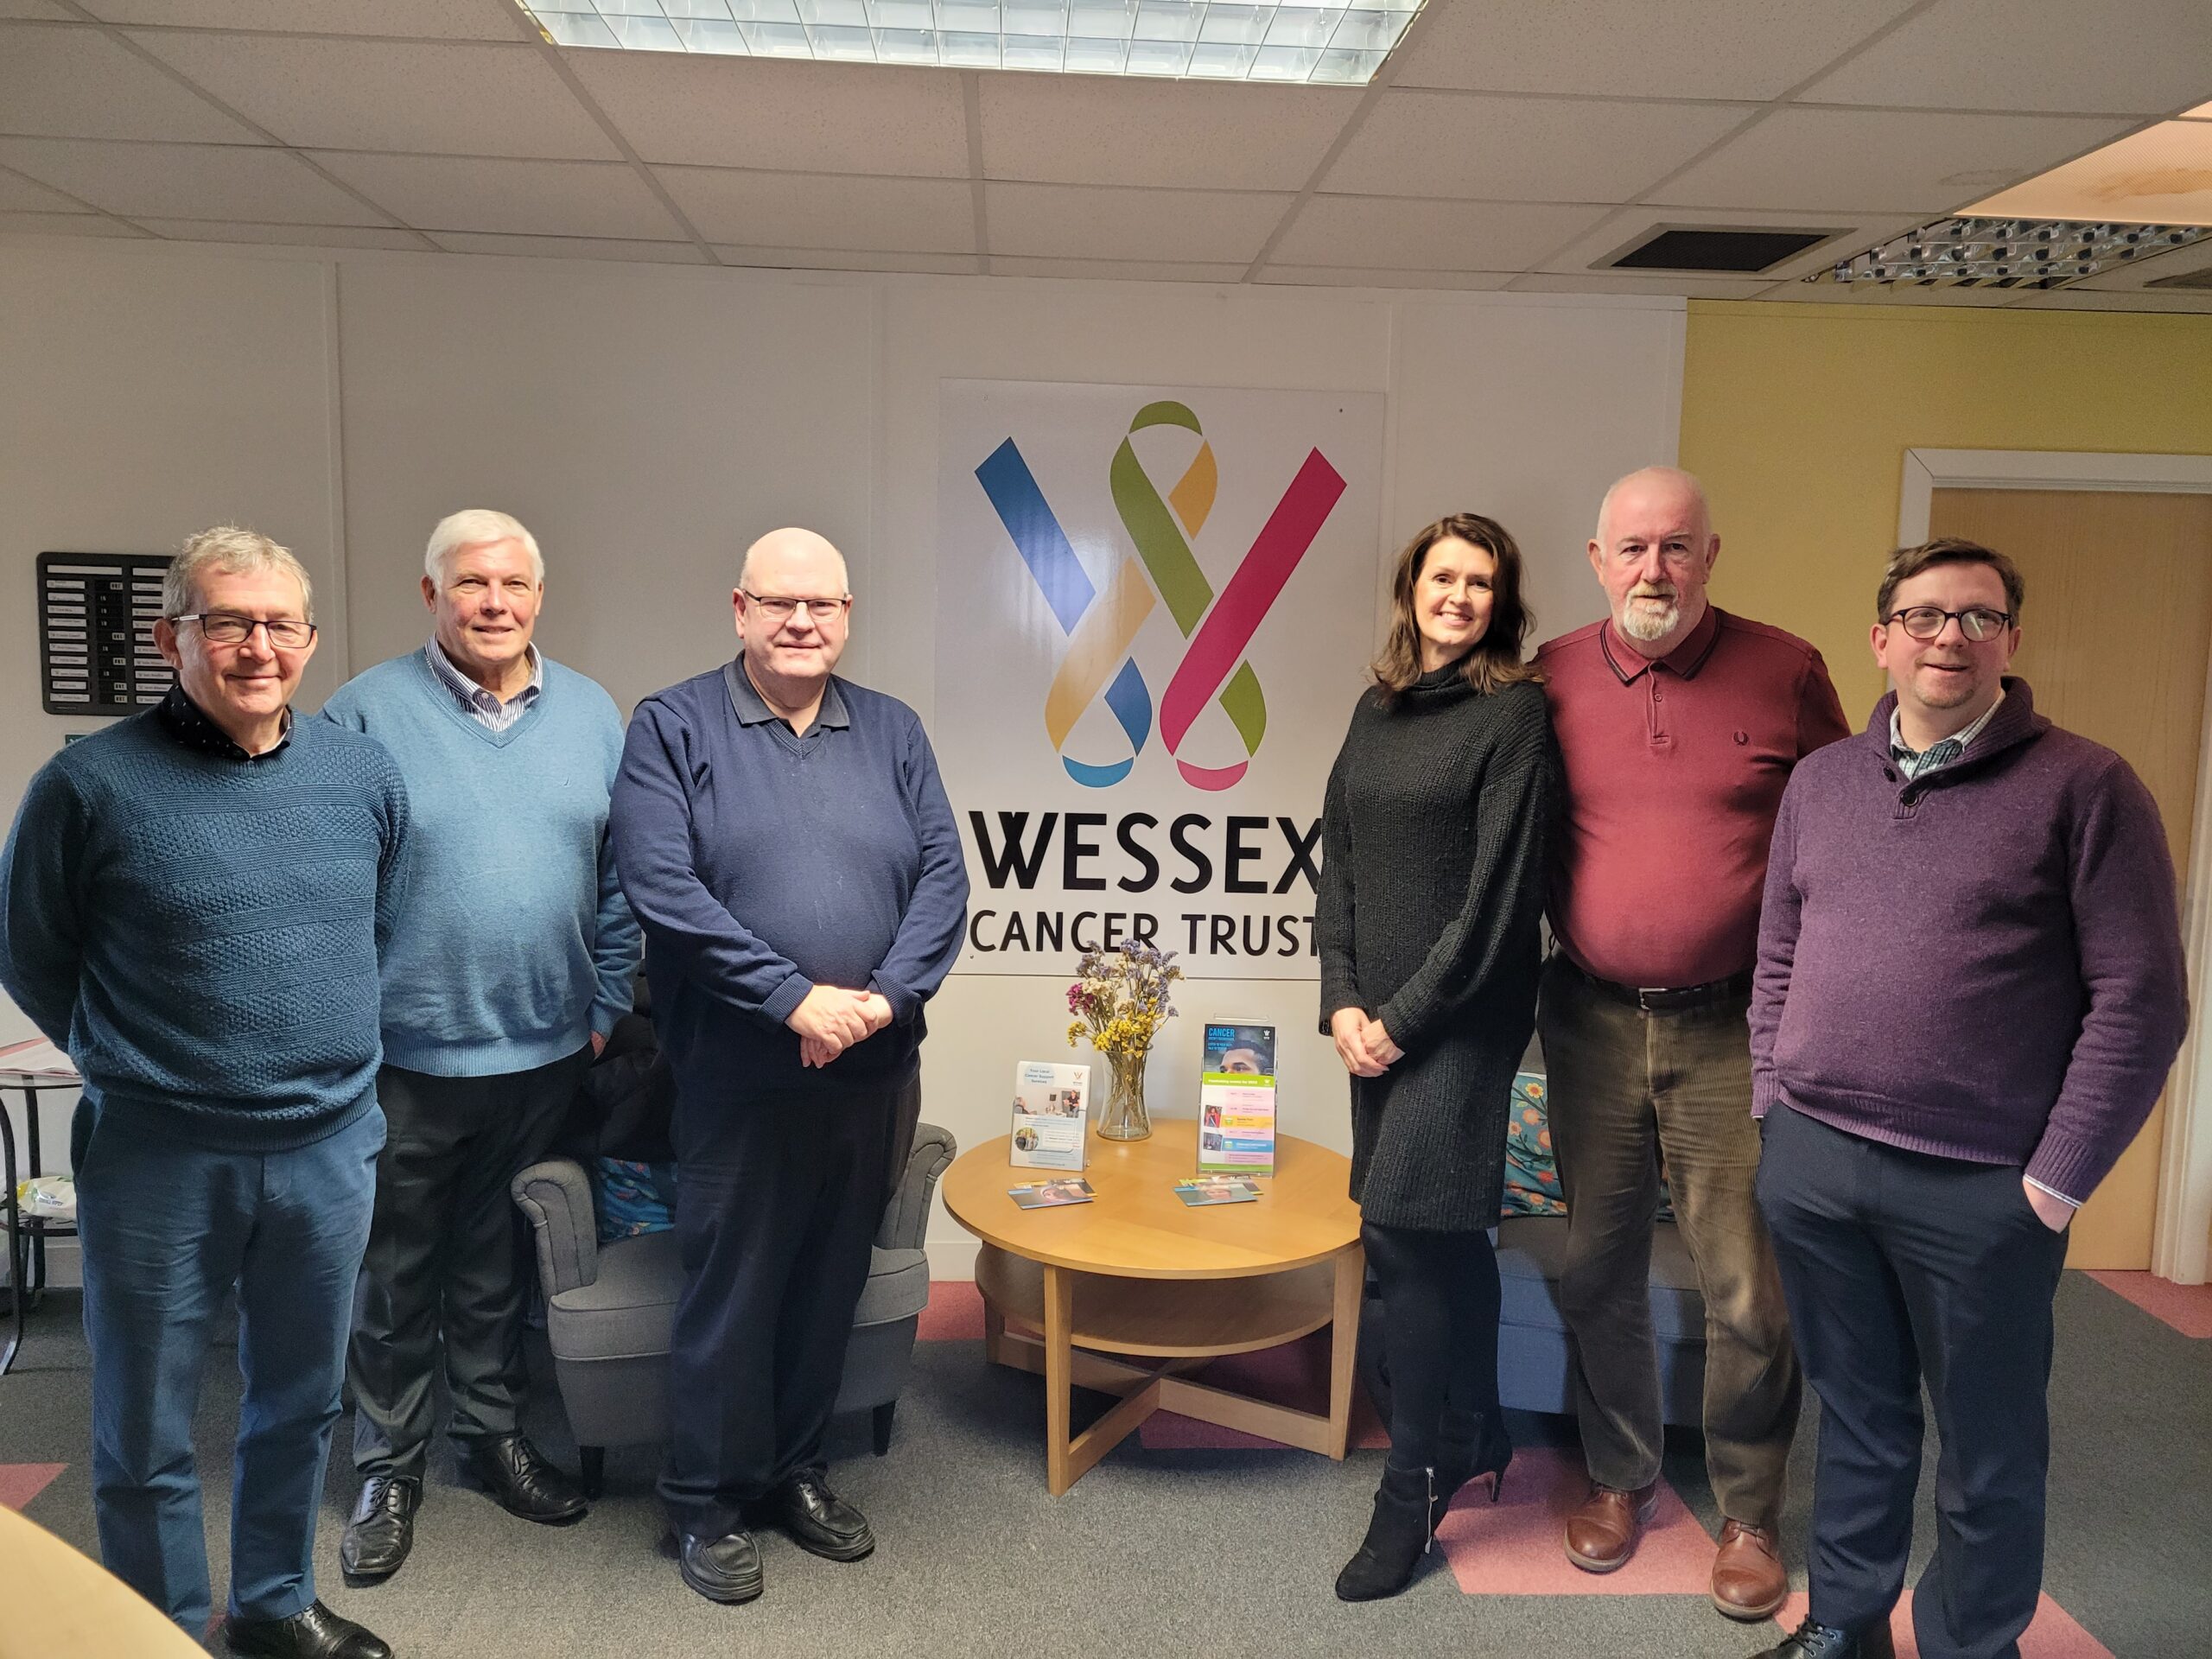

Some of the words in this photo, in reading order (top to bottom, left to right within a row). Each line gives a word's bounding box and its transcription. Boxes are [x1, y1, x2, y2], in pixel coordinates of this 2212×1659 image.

[969, 810, 1322, 893] WESSEX
[969, 910, 1159, 953] CANCER
[1181, 913, 1318, 957] TRUST
[1209, 1027, 1235, 1037] CANCER
